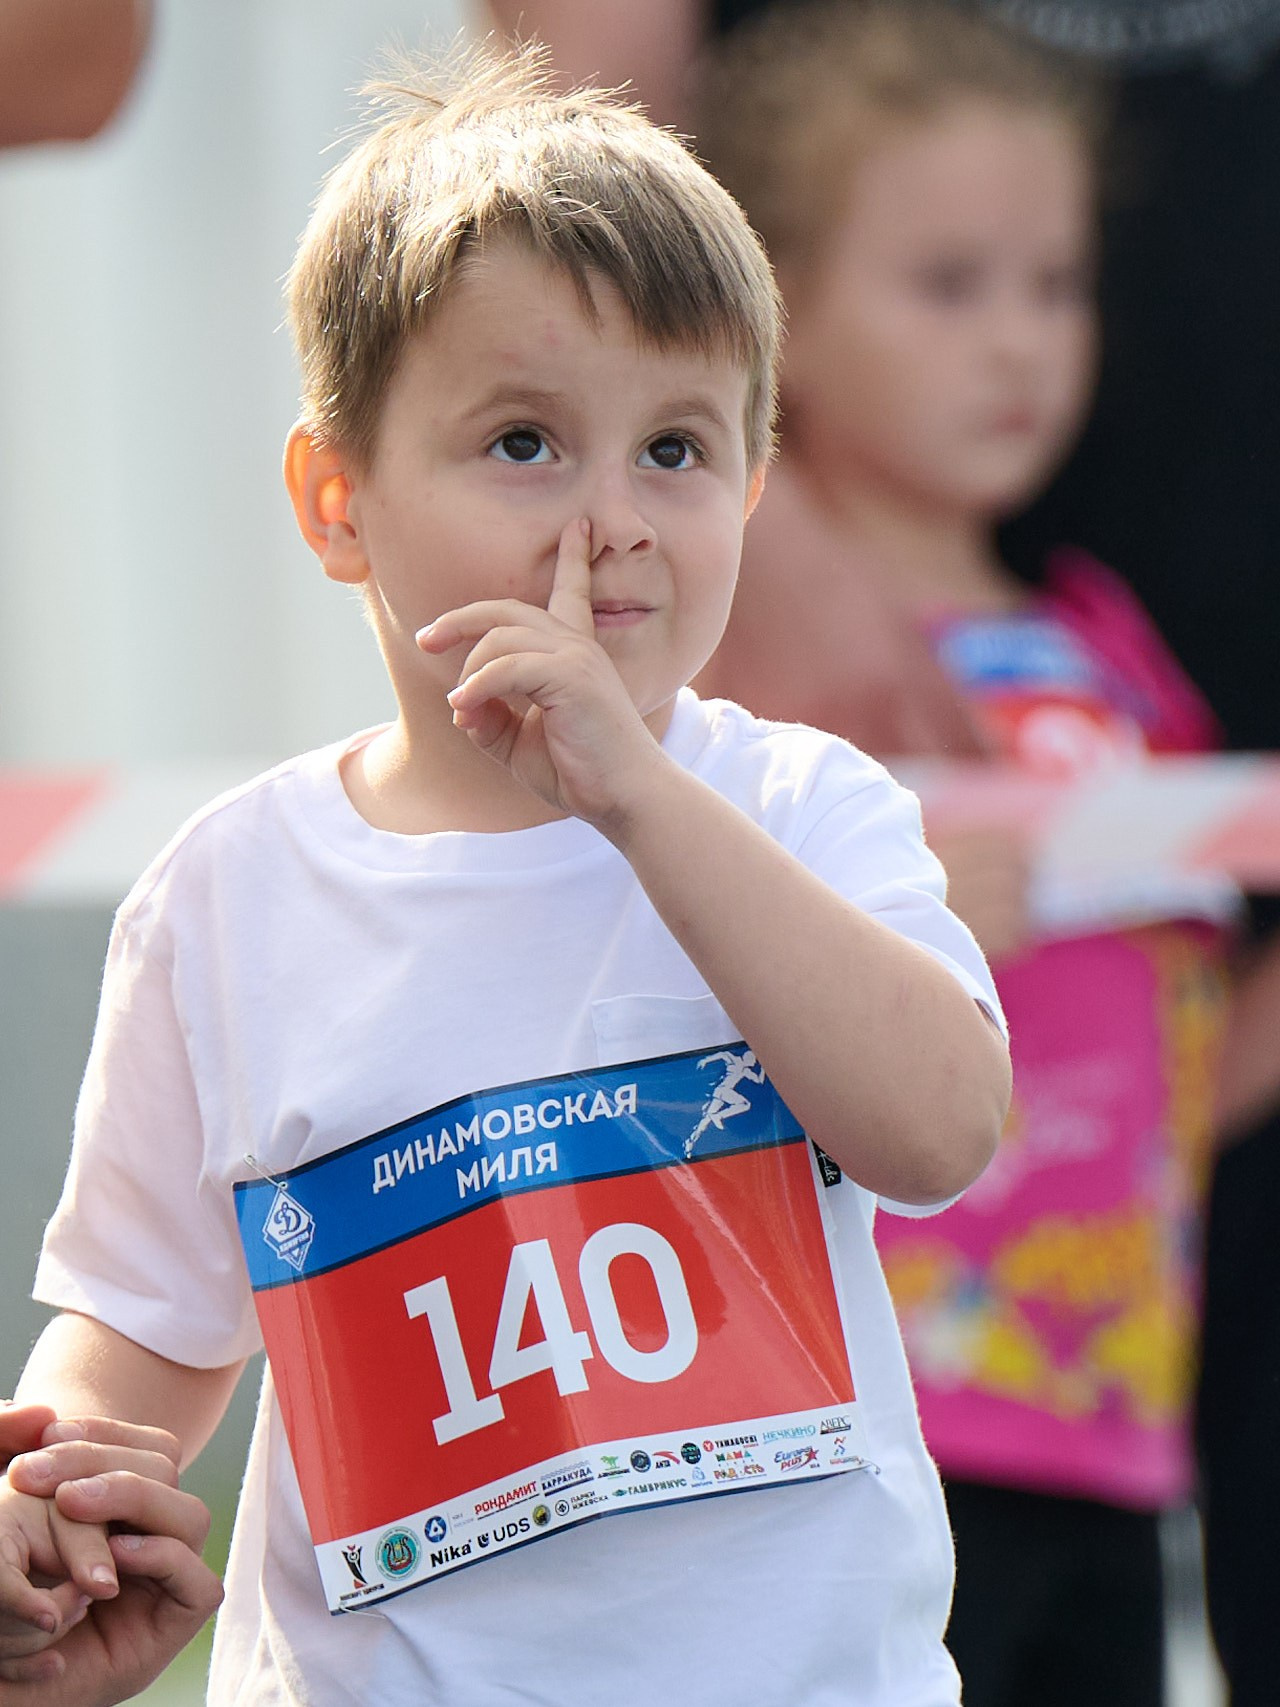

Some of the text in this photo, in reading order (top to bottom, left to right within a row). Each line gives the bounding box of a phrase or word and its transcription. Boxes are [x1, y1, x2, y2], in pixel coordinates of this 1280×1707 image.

[371, 1083, 638, 1194] ДИНАМОВСКАЯ
[455, 1140, 559, 1199] МИЛЯ
[403, 1222, 700, 1446] 140
[762, 1424, 816, 1440] НЕЧКИНО
[474, 1481, 538, 1515] РОНДАМИТ
[493, 1517, 531, 1542] UDS
[430, 1543, 472, 1568] Nika
